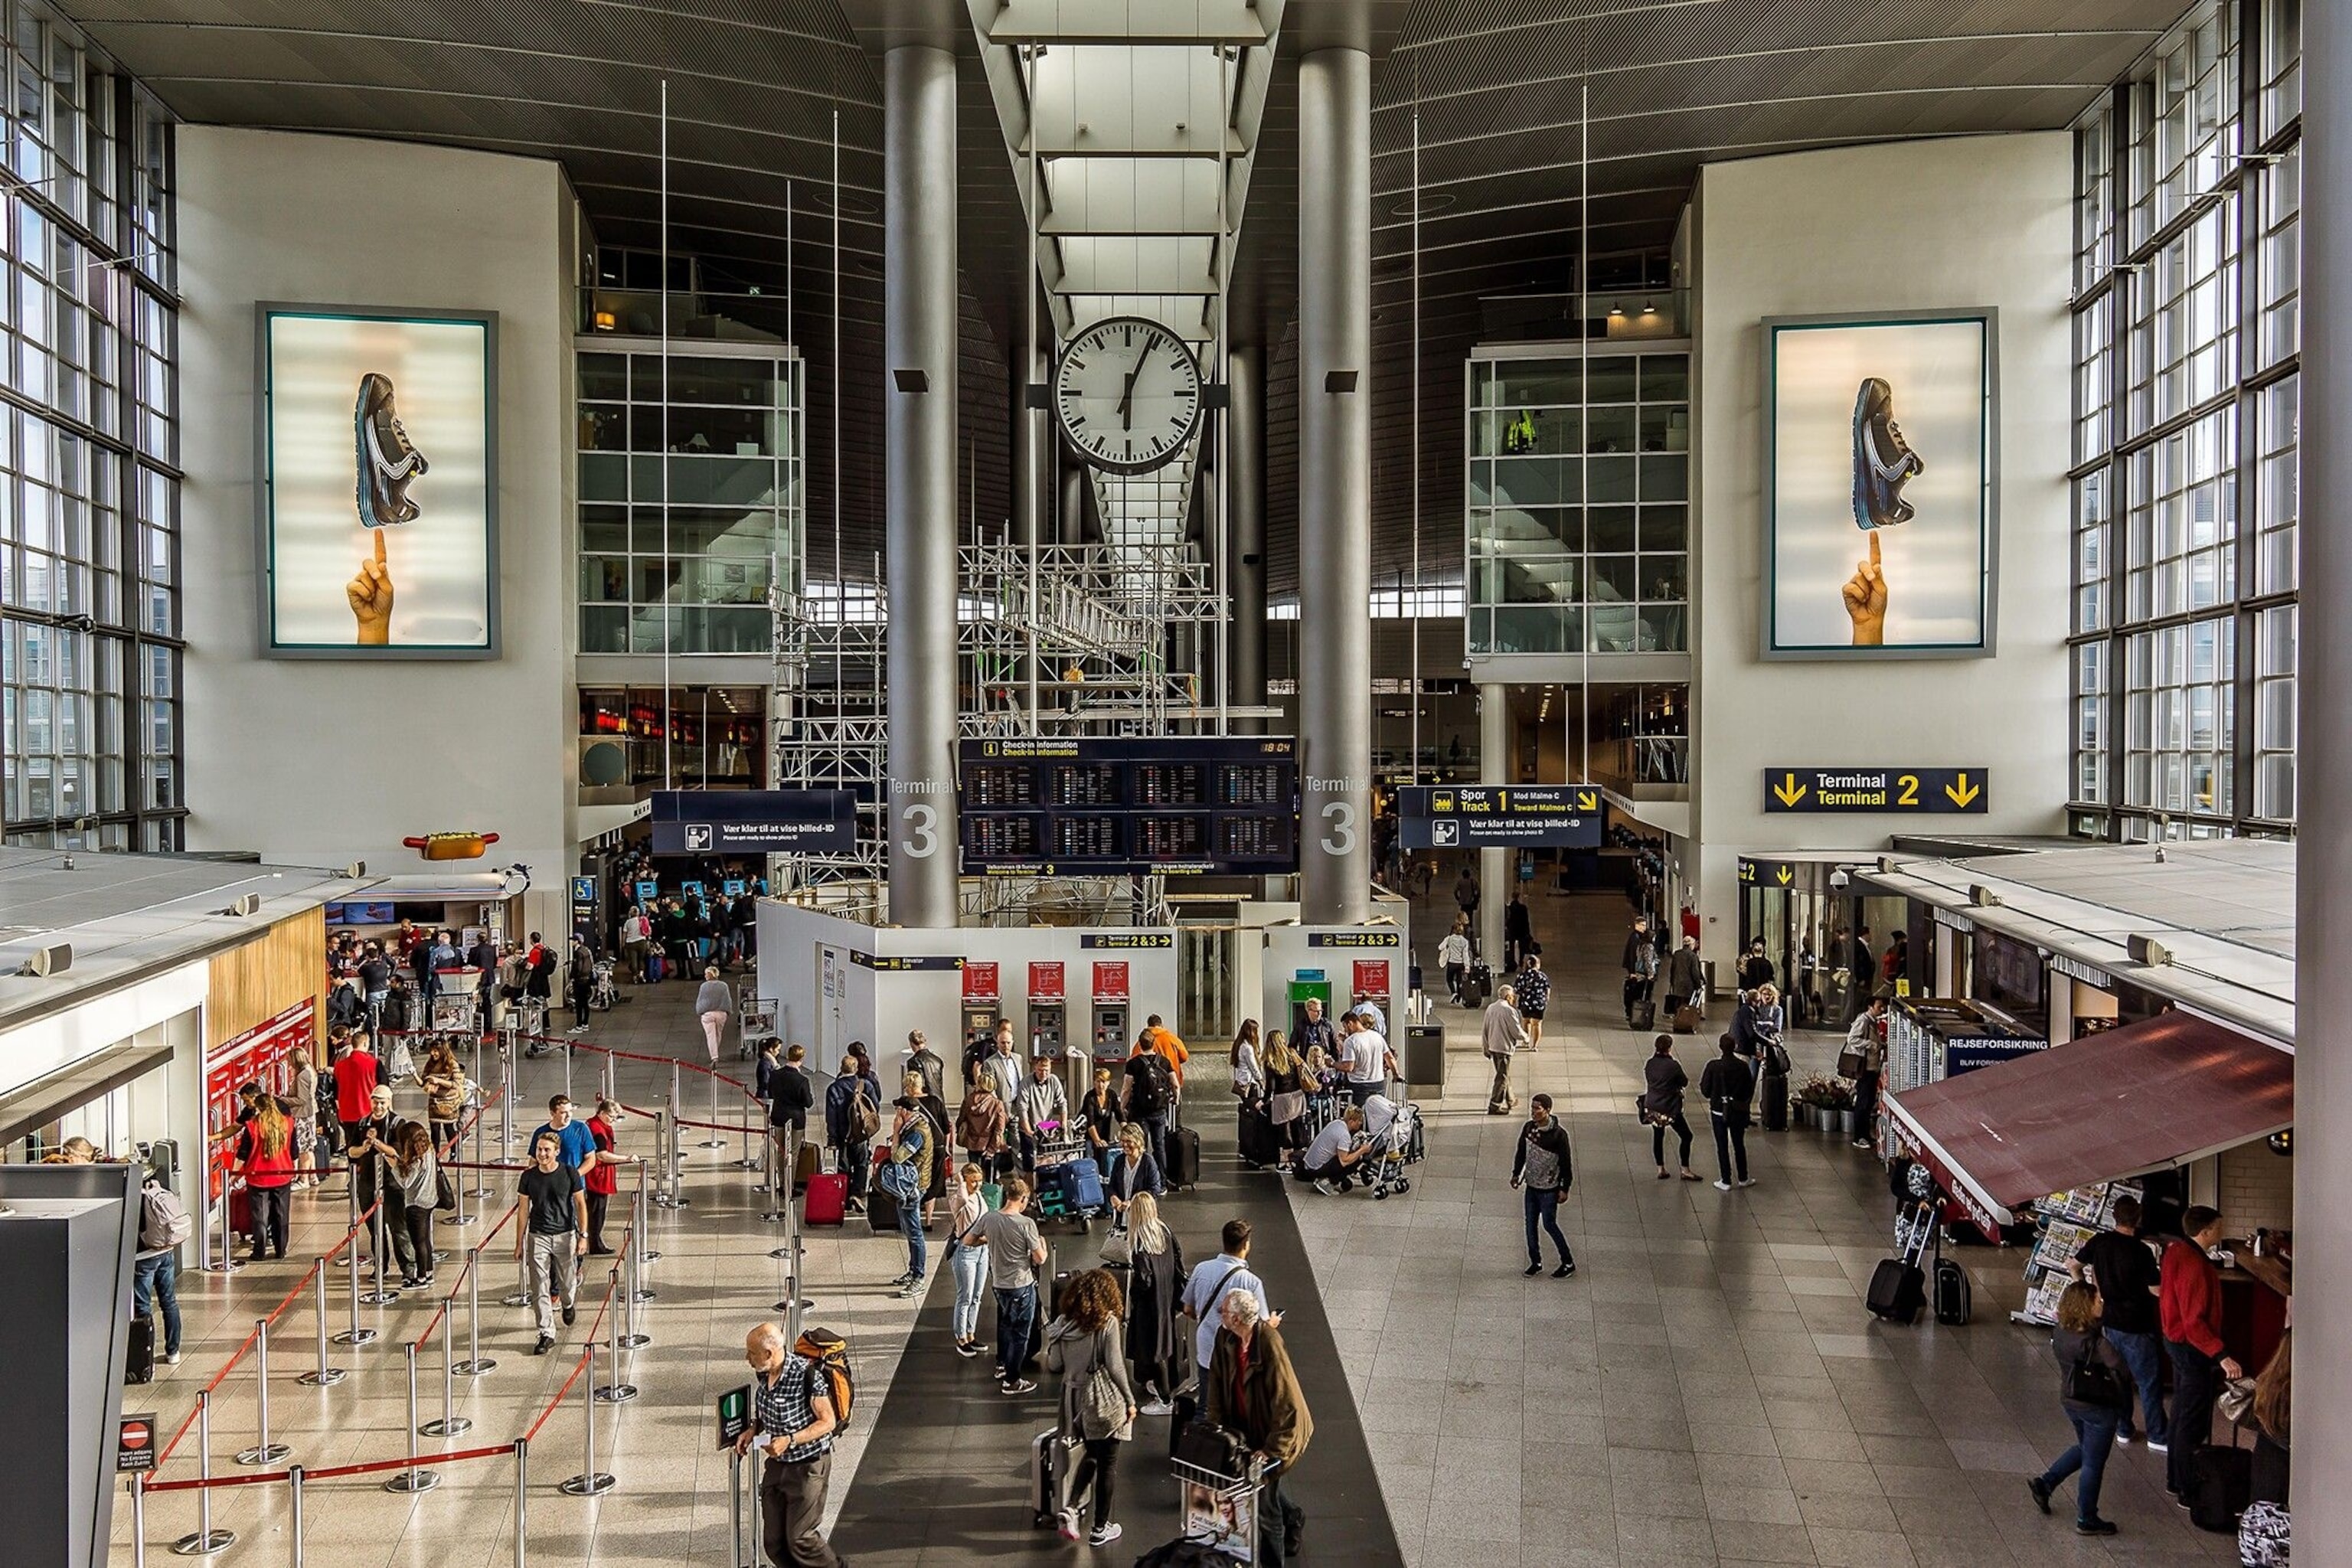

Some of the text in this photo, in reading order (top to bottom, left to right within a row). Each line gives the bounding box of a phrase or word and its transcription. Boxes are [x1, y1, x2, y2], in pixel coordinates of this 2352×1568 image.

[890, 778, 953, 793] Terminal
[1305, 776, 1368, 791] Terminal
[1817, 773, 1886, 788] Terminal
[1461, 789, 1485, 801] Spor
[1897, 775, 1919, 805] 2
[1498, 791, 1507, 811] 1
[1817, 791, 1886, 805] Terminal
[1461, 802, 1490, 812] Track
[799, 824, 835, 832] billed-ID
[1321, 802, 1356, 855] 3
[1470, 819, 1486, 828] Vær
[1488, 819, 1504, 828] klar
[1505, 819, 1514, 828] til
[1526, 819, 1544, 828] vise
[1545, 819, 1580, 828] billed-ID
[903, 804, 938, 858] 3
[1047, 864, 1054, 874] 3
[1748, 864, 1755, 880] 2
[1131, 936, 1157, 946] 2 & 3
[1358, 935, 1383, 946] 2 & 3
[1949, 1039, 2048, 1050] REJSEFORSIKRING
